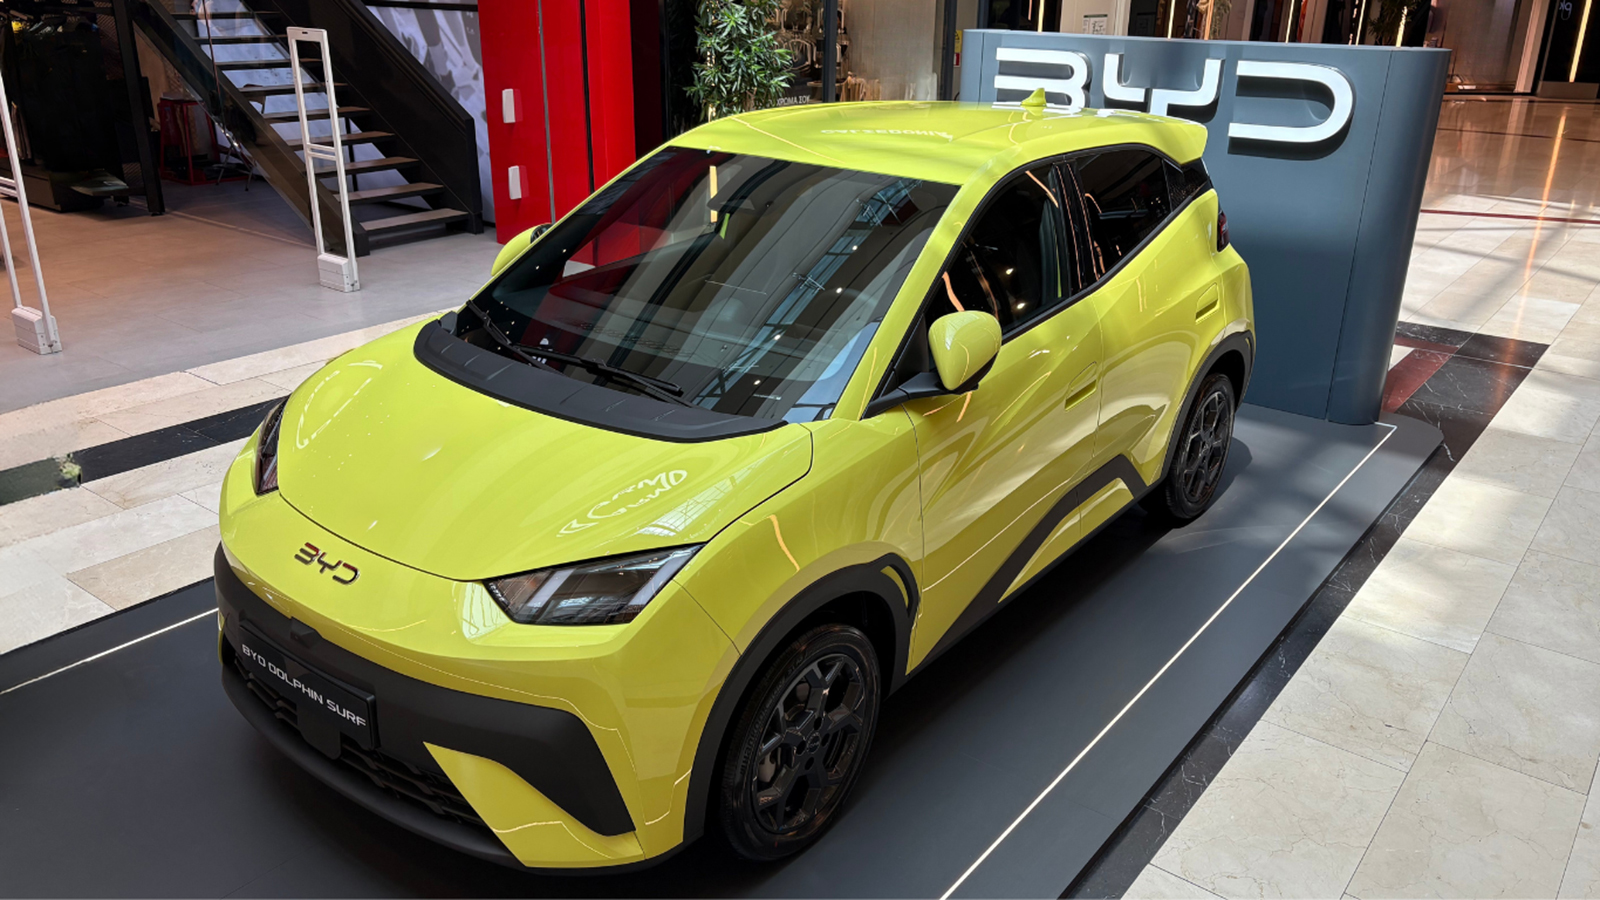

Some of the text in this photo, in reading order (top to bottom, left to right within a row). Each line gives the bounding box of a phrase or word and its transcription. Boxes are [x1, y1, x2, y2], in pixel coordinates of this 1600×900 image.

[992, 47, 1354, 143] BYD
[294, 541, 360, 585] BYD
[242, 643, 367, 726] BYD DOLPHIN SURF
